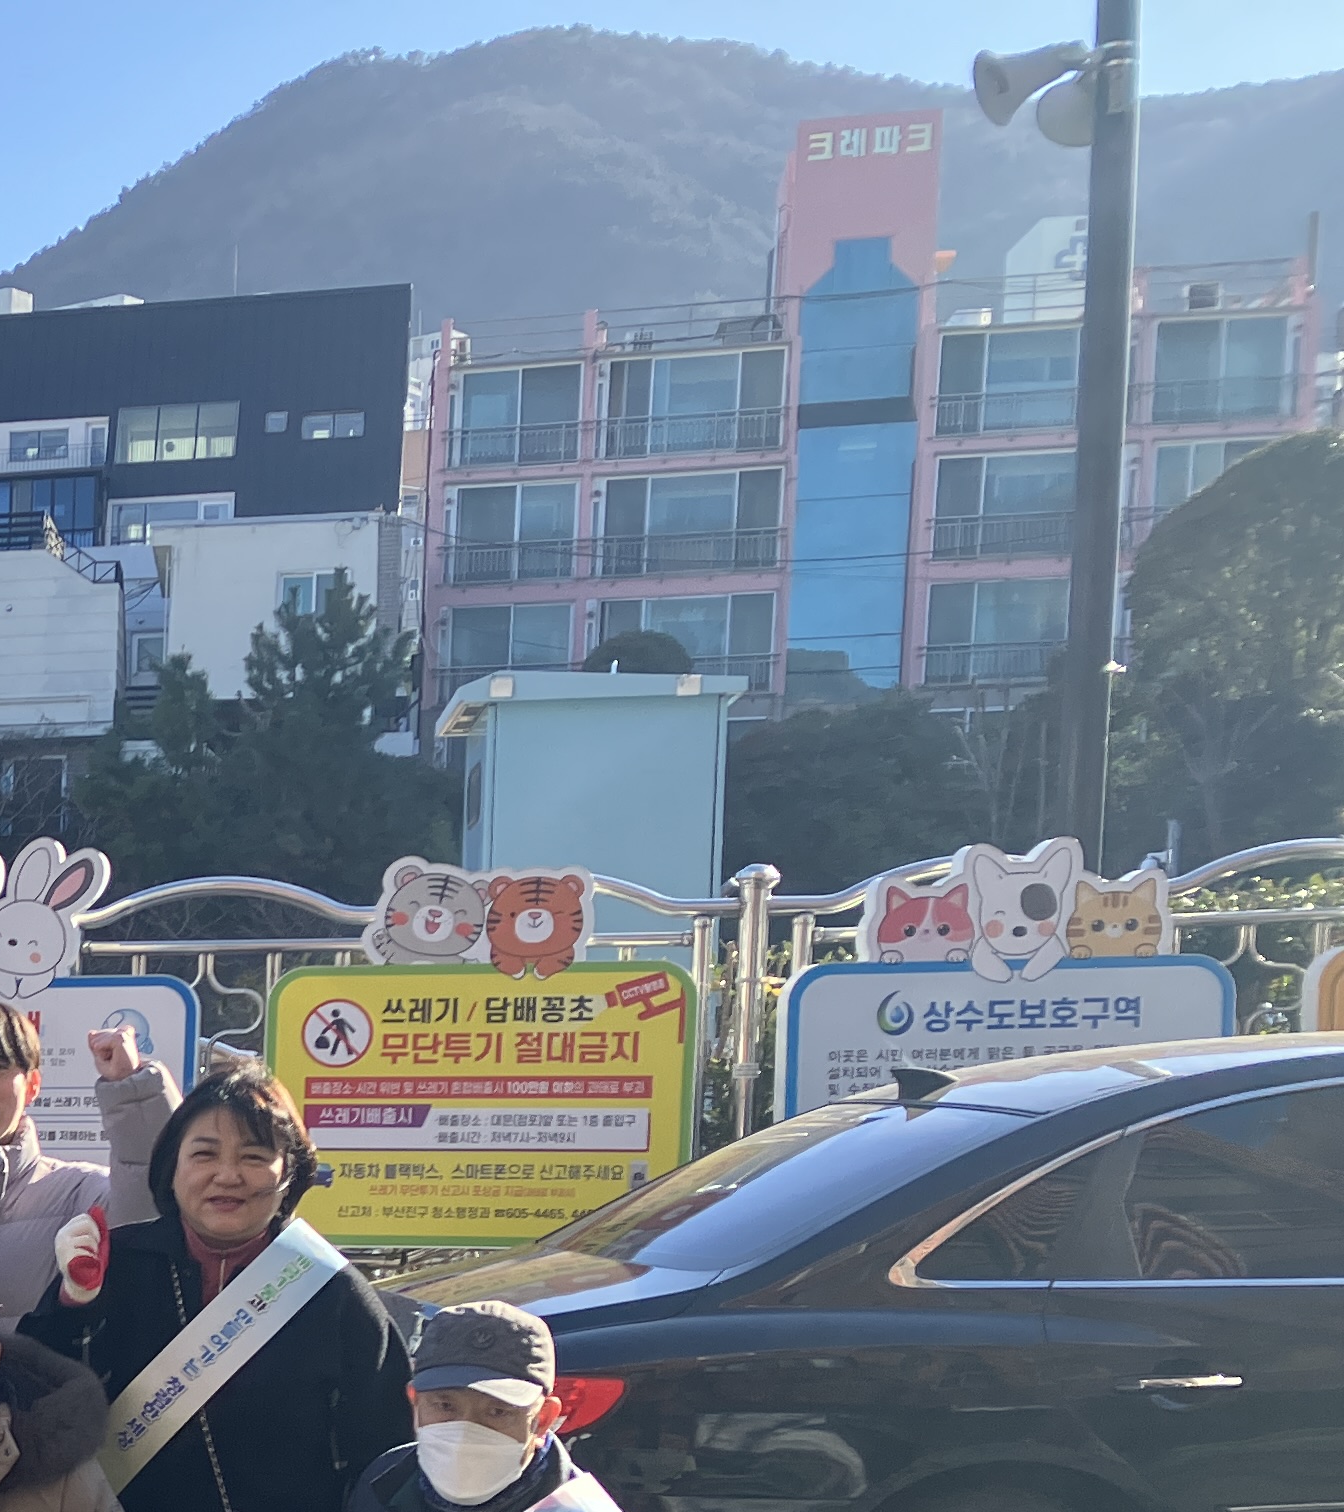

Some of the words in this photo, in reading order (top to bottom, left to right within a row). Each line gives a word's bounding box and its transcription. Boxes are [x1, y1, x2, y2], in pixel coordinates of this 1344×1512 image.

[807, 122, 933, 161] 크레파크
[380, 996, 460, 1025] 쓰레기
[484, 995, 594, 1024] 담배꽁초
[923, 996, 1143, 1033] 상수도보호구역
[380, 1031, 503, 1065] 무단투기
[514, 1031, 641, 1064] 절대금지
[416, 1081, 448, 1094] 쓰레기
[319, 1107, 413, 1125] 쓰레기배출시
[338, 1163, 380, 1179] 자동차
[451, 1163, 535, 1180] 스마트폰으로
[540, 1164, 624, 1180] 신고해주세요
[337, 1206, 372, 1218] 신고처
[382, 1206, 428, 1218] 부산진구
